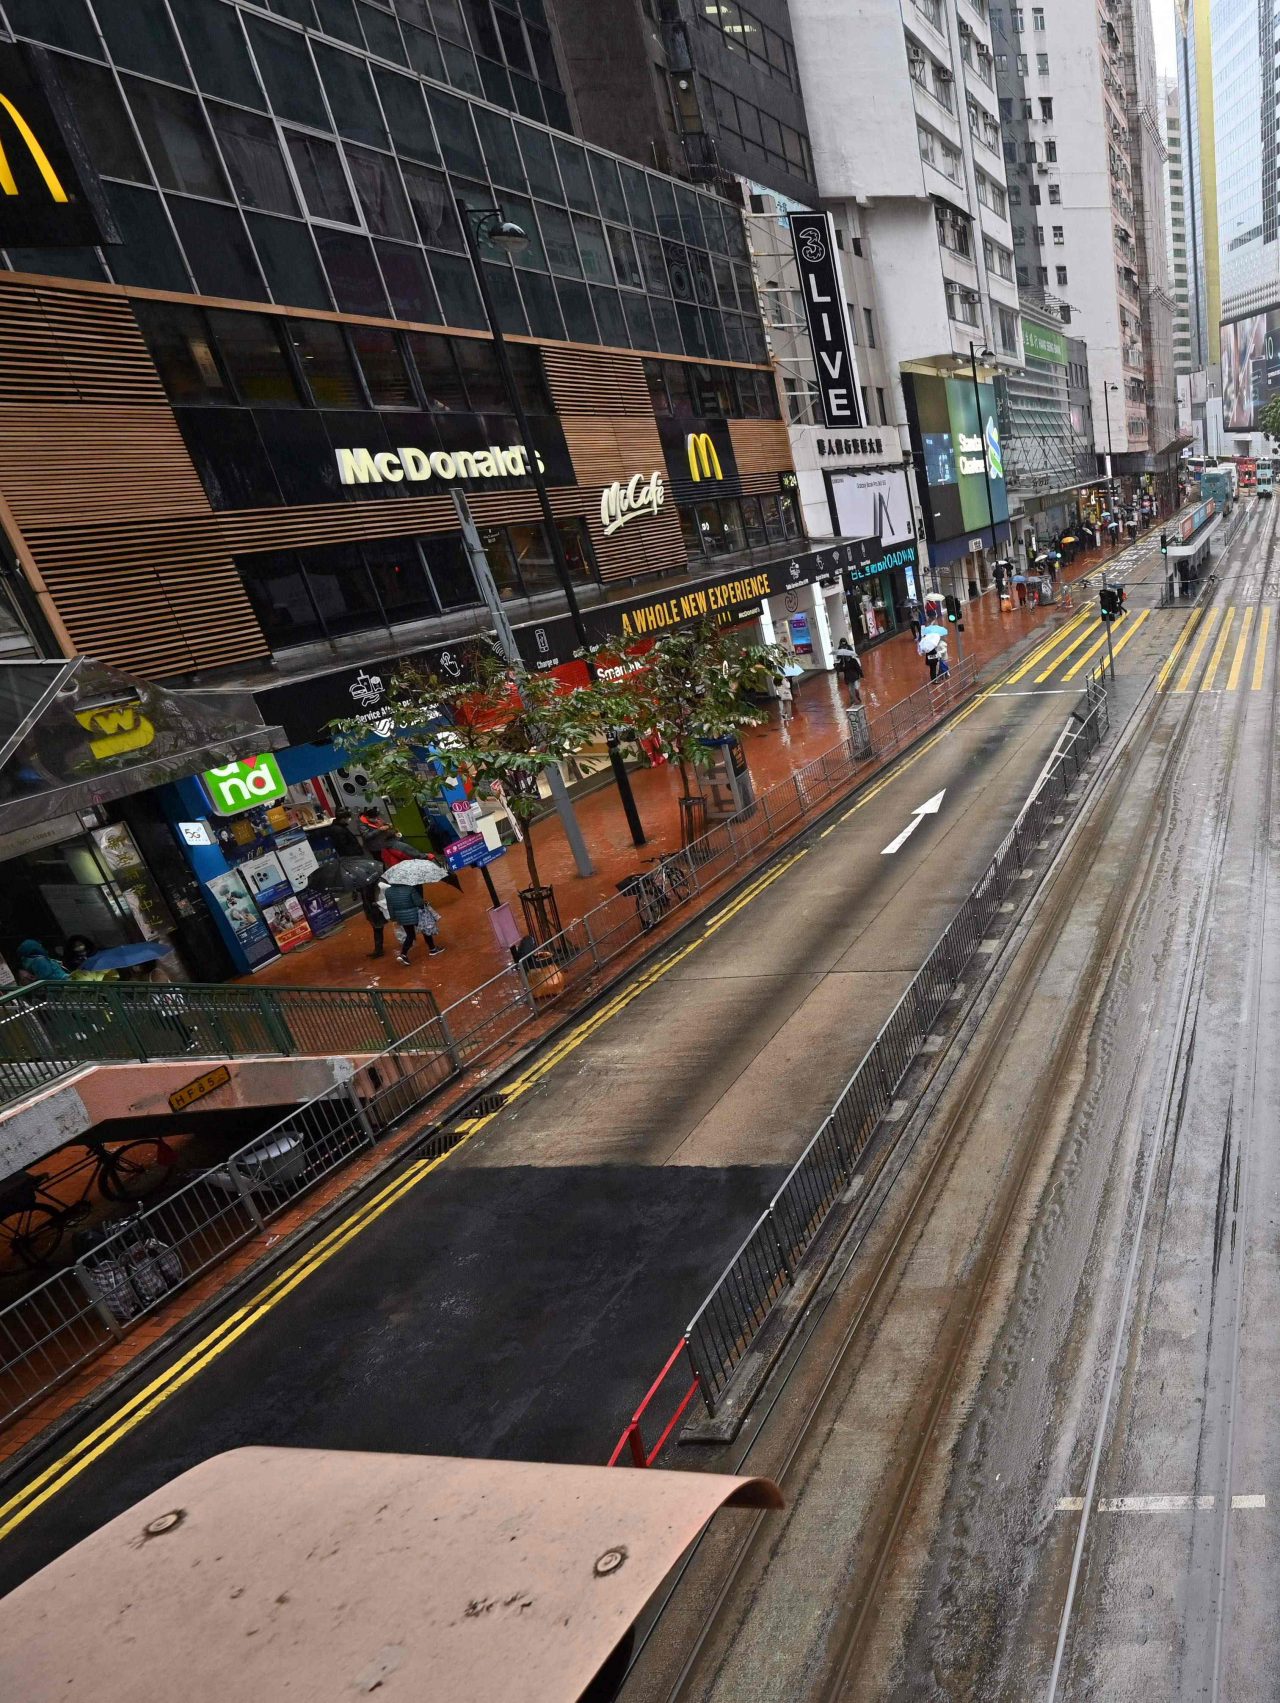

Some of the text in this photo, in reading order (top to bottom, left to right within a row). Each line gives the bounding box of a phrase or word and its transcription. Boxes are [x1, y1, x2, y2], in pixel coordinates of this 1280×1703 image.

[809, 273, 851, 417] LIVE
[335, 445, 545, 485] McDonald's
[632, 597, 681, 633] WHOLE
[680, 590, 708, 619] NEW
[709, 572, 771, 610] EXPERIENCE
